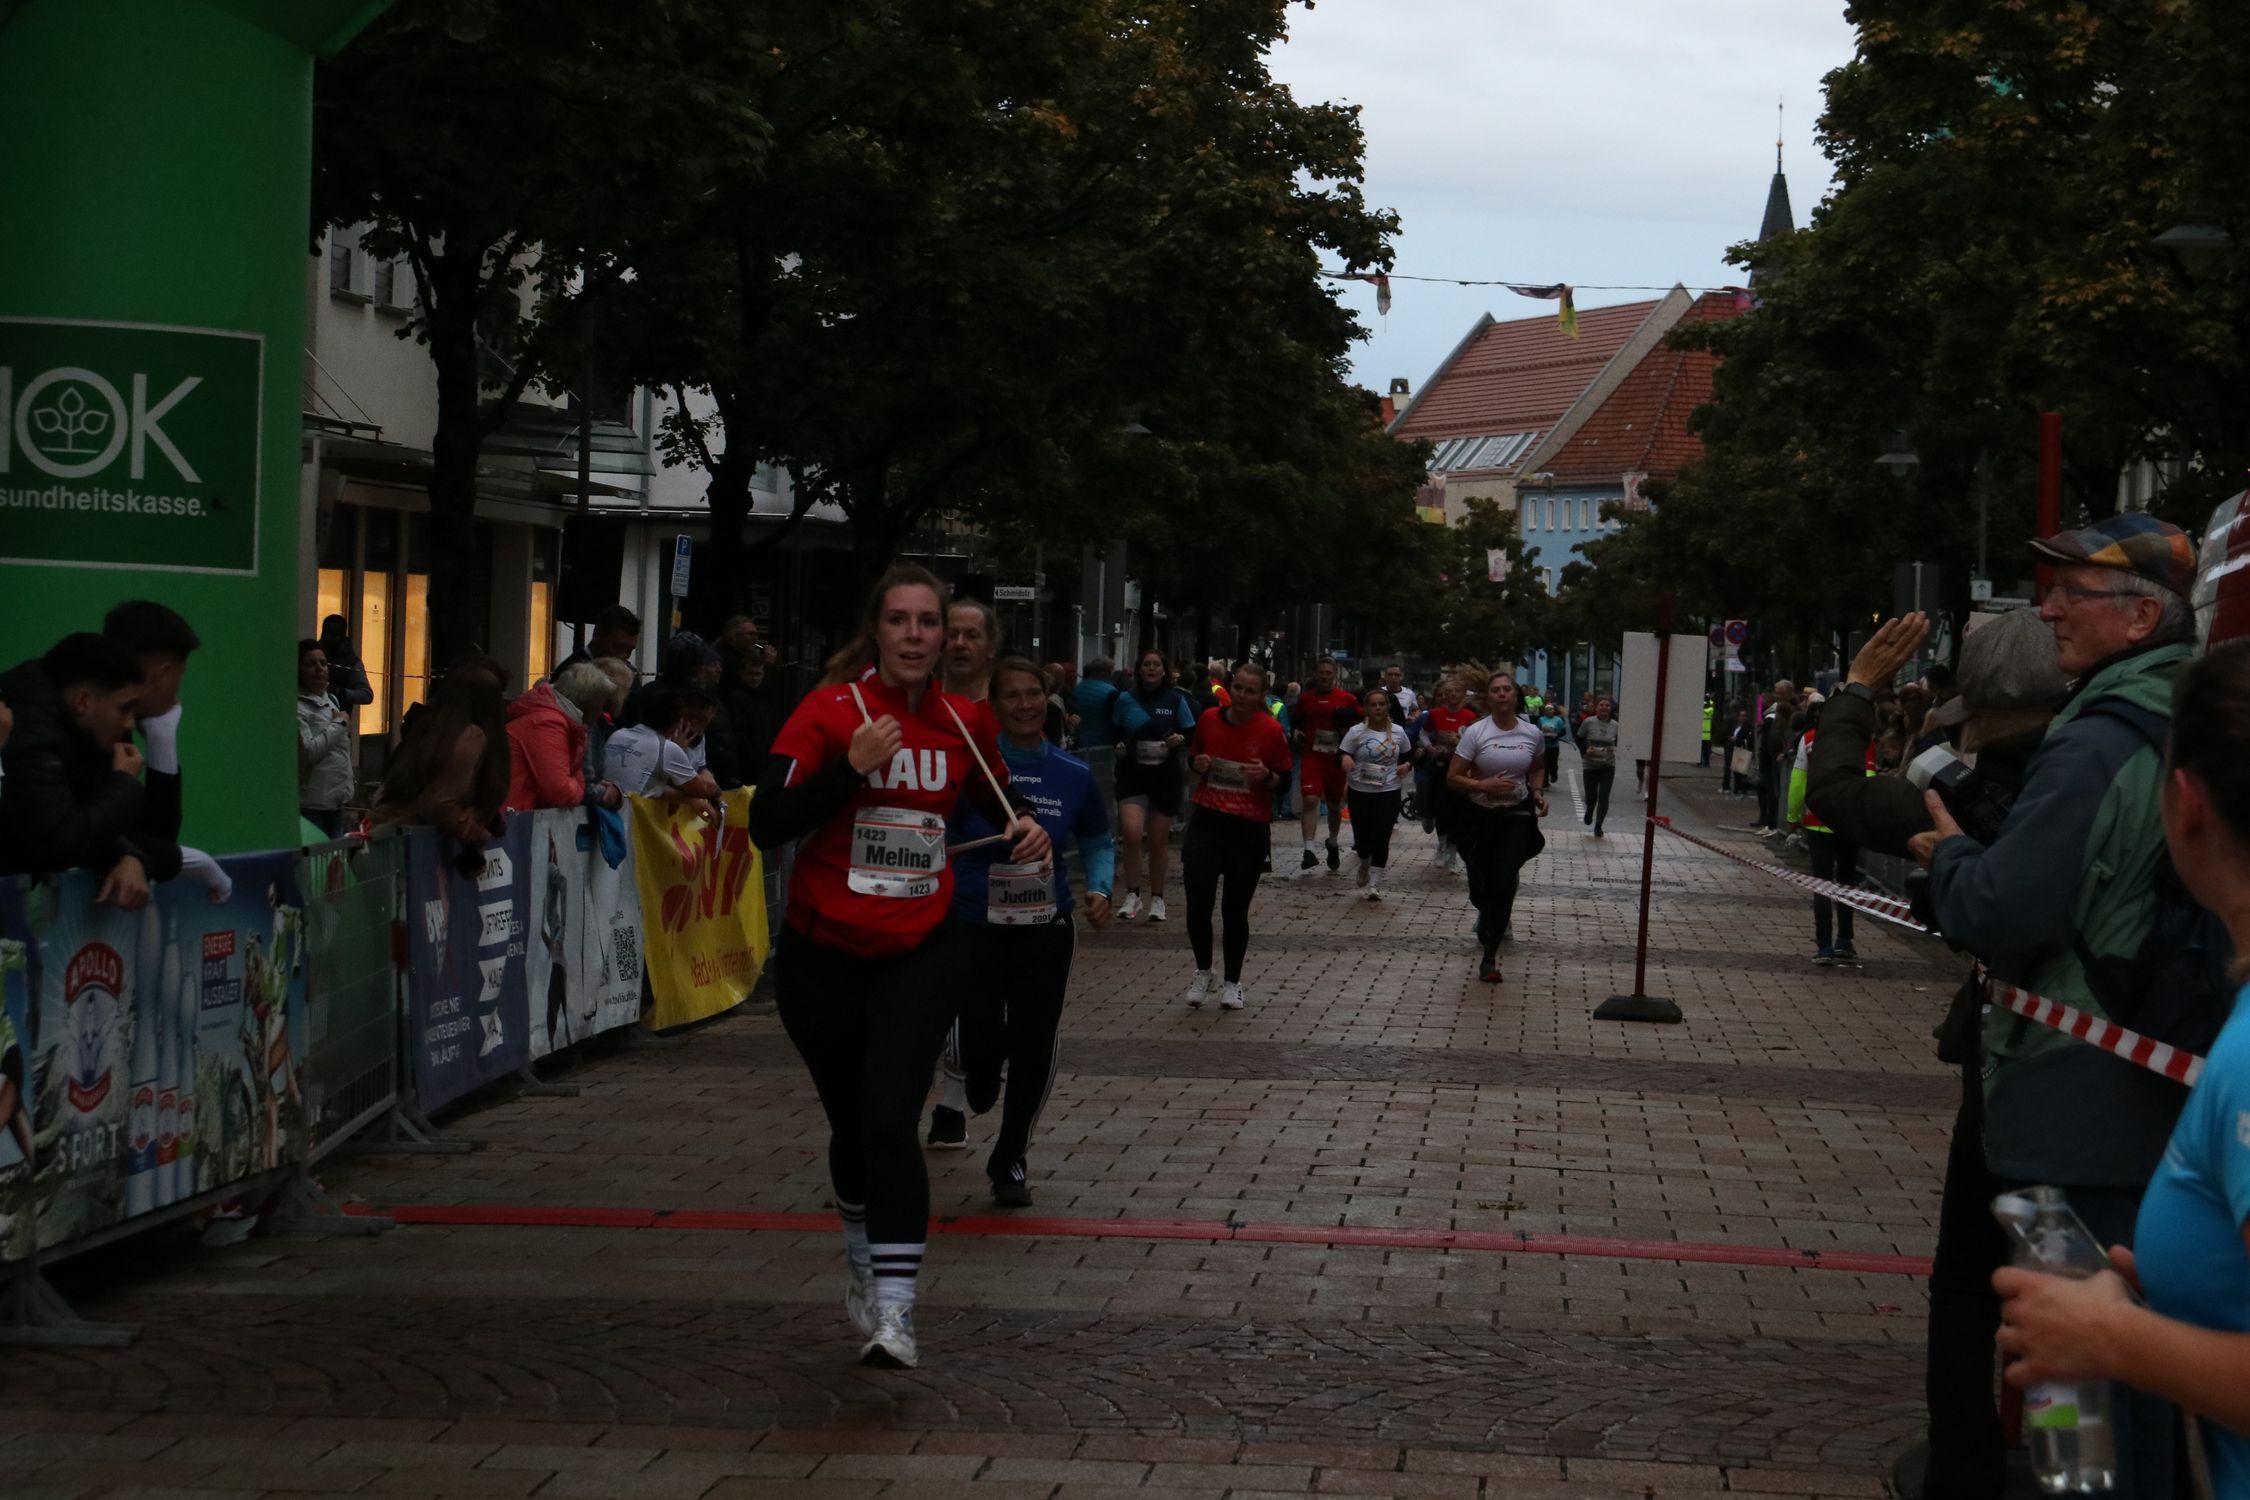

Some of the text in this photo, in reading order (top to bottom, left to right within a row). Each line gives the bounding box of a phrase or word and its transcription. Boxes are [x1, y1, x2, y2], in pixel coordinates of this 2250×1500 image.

[0, 366, 204, 484] OK
[861, 748, 948, 792] AU
[1012, 774, 1042, 784] Kempa
[857, 829, 886, 841] 1423
[865, 844, 932, 869] Melina
[909, 883, 931, 896] 1423
[998, 888, 1046, 904] Judith
[71, 951, 118, 988] APOLLO
[57, 1125, 120, 1173] SPORT
